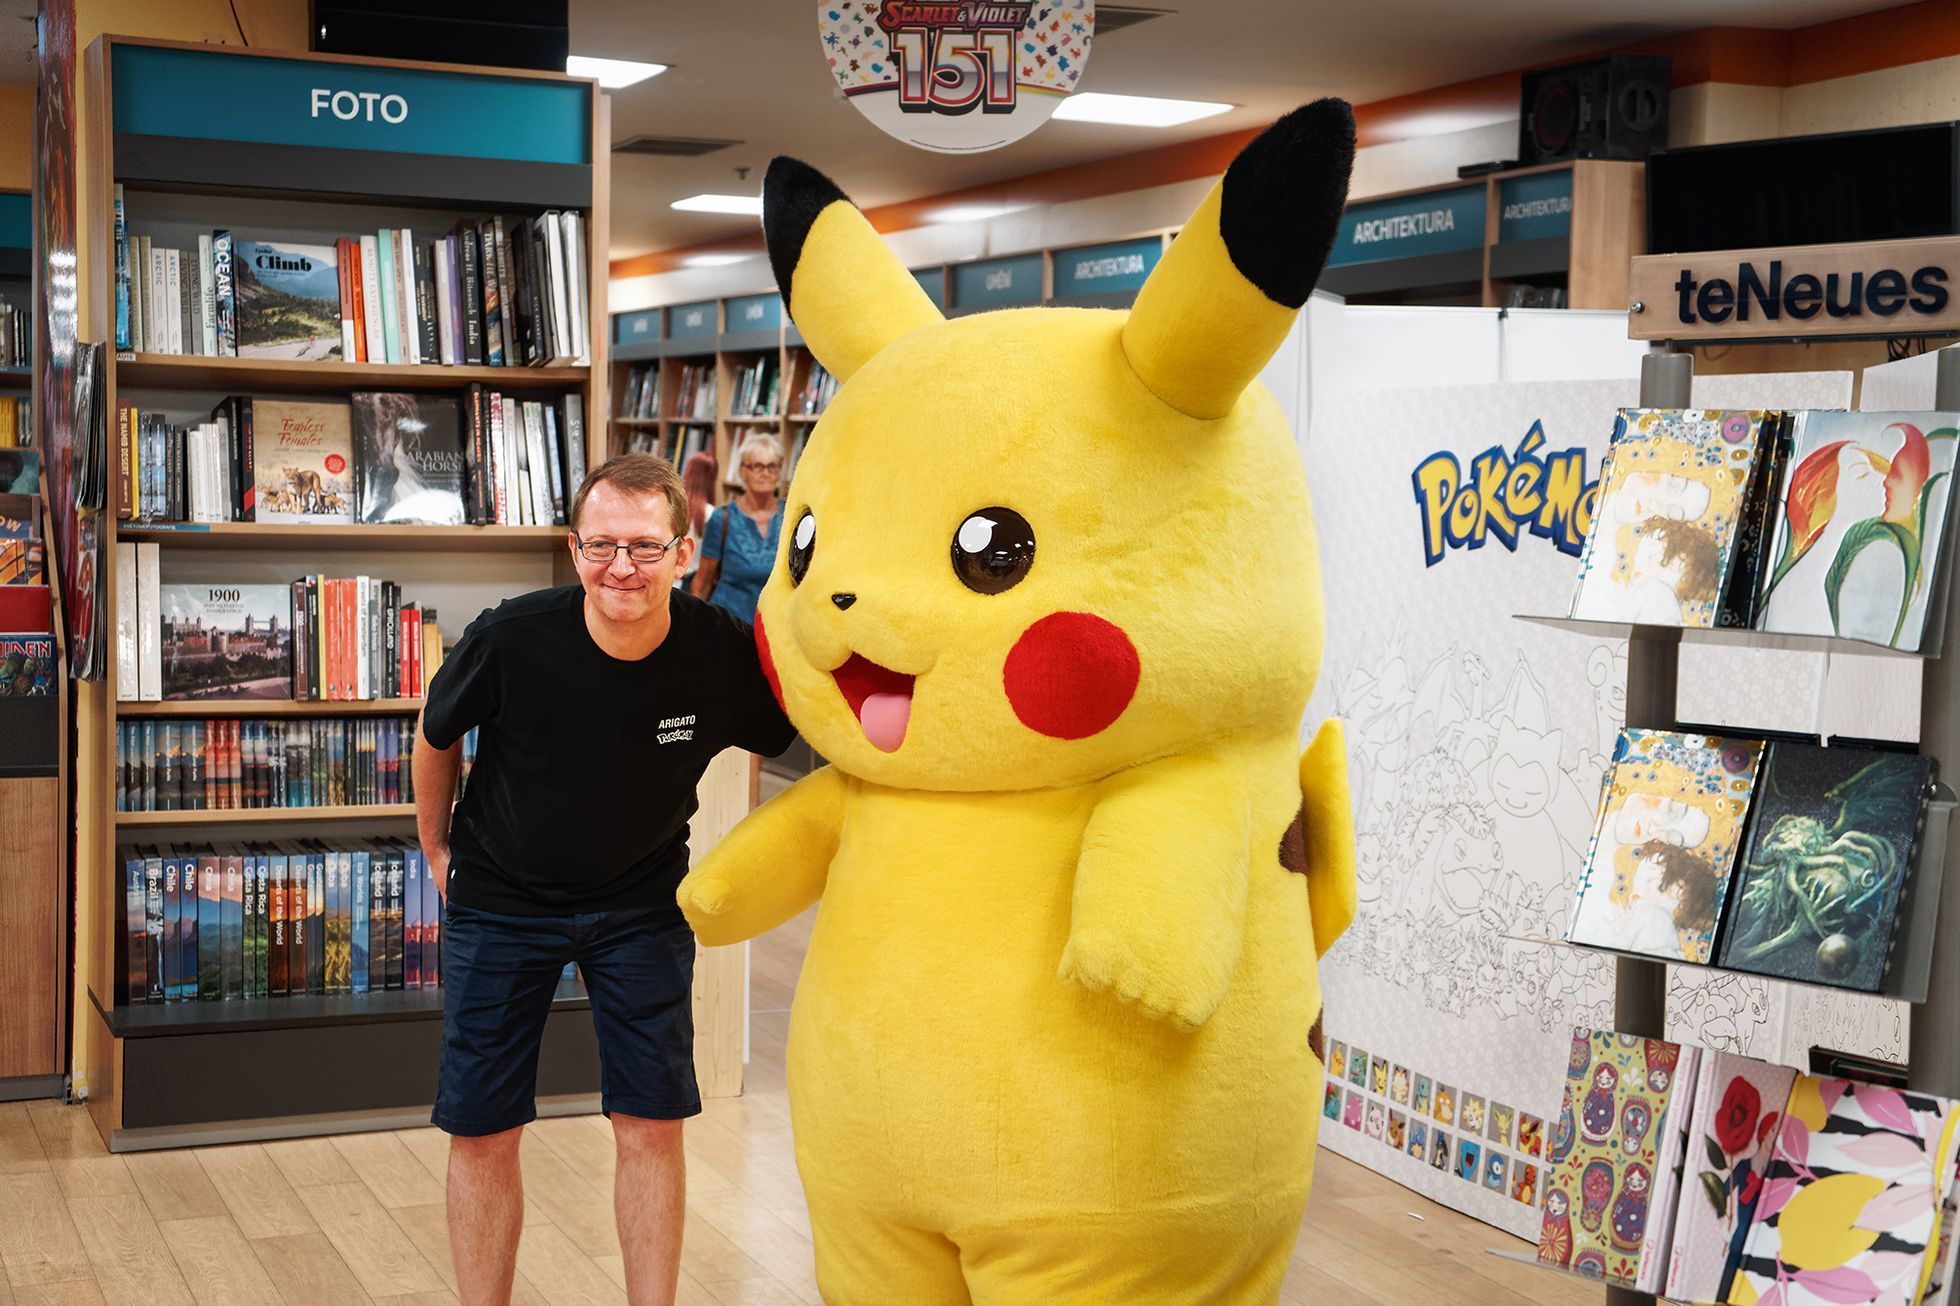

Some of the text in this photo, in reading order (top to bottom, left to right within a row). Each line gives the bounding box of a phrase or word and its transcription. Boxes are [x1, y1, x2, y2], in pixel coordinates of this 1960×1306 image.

[881, 1, 958, 27] SCARLET
[961, 2, 1026, 30] VIOLET
[889, 28, 1016, 114] 151
[310, 88, 408, 124] FOTO
[1352, 209, 1454, 244] ARCHITEKTURA
[484, 232, 494, 260] DARK
[214, 236, 232, 297] OCEAN
[256, 256, 312, 272] Climb
[1074, 254, 1145, 280] ARCHITEKTURA
[500, 285, 510, 319] SCOTLAND
[1675, 260, 1949, 325] teNeues
[206, 286, 215, 329] Farmlife
[468, 320, 478, 345] India
[281, 416, 325, 432] Fearless
[278, 432, 322, 446] Females
[407, 451, 464, 461] ARABIAN
[209, 589, 240, 602] 1900
[0, 640, 52, 658] IDEN
[658, 714, 696, 730] ARIGATO
[149, 868, 159, 900] Brazil
[166, 865, 176, 892] Chile
[184, 864, 194, 891] Chile
[244, 866, 254, 915] Costa Rica
[258, 866, 266, 914] Costa Rica
[276, 897, 282, 906] of
[296, 896, 302, 906] of
